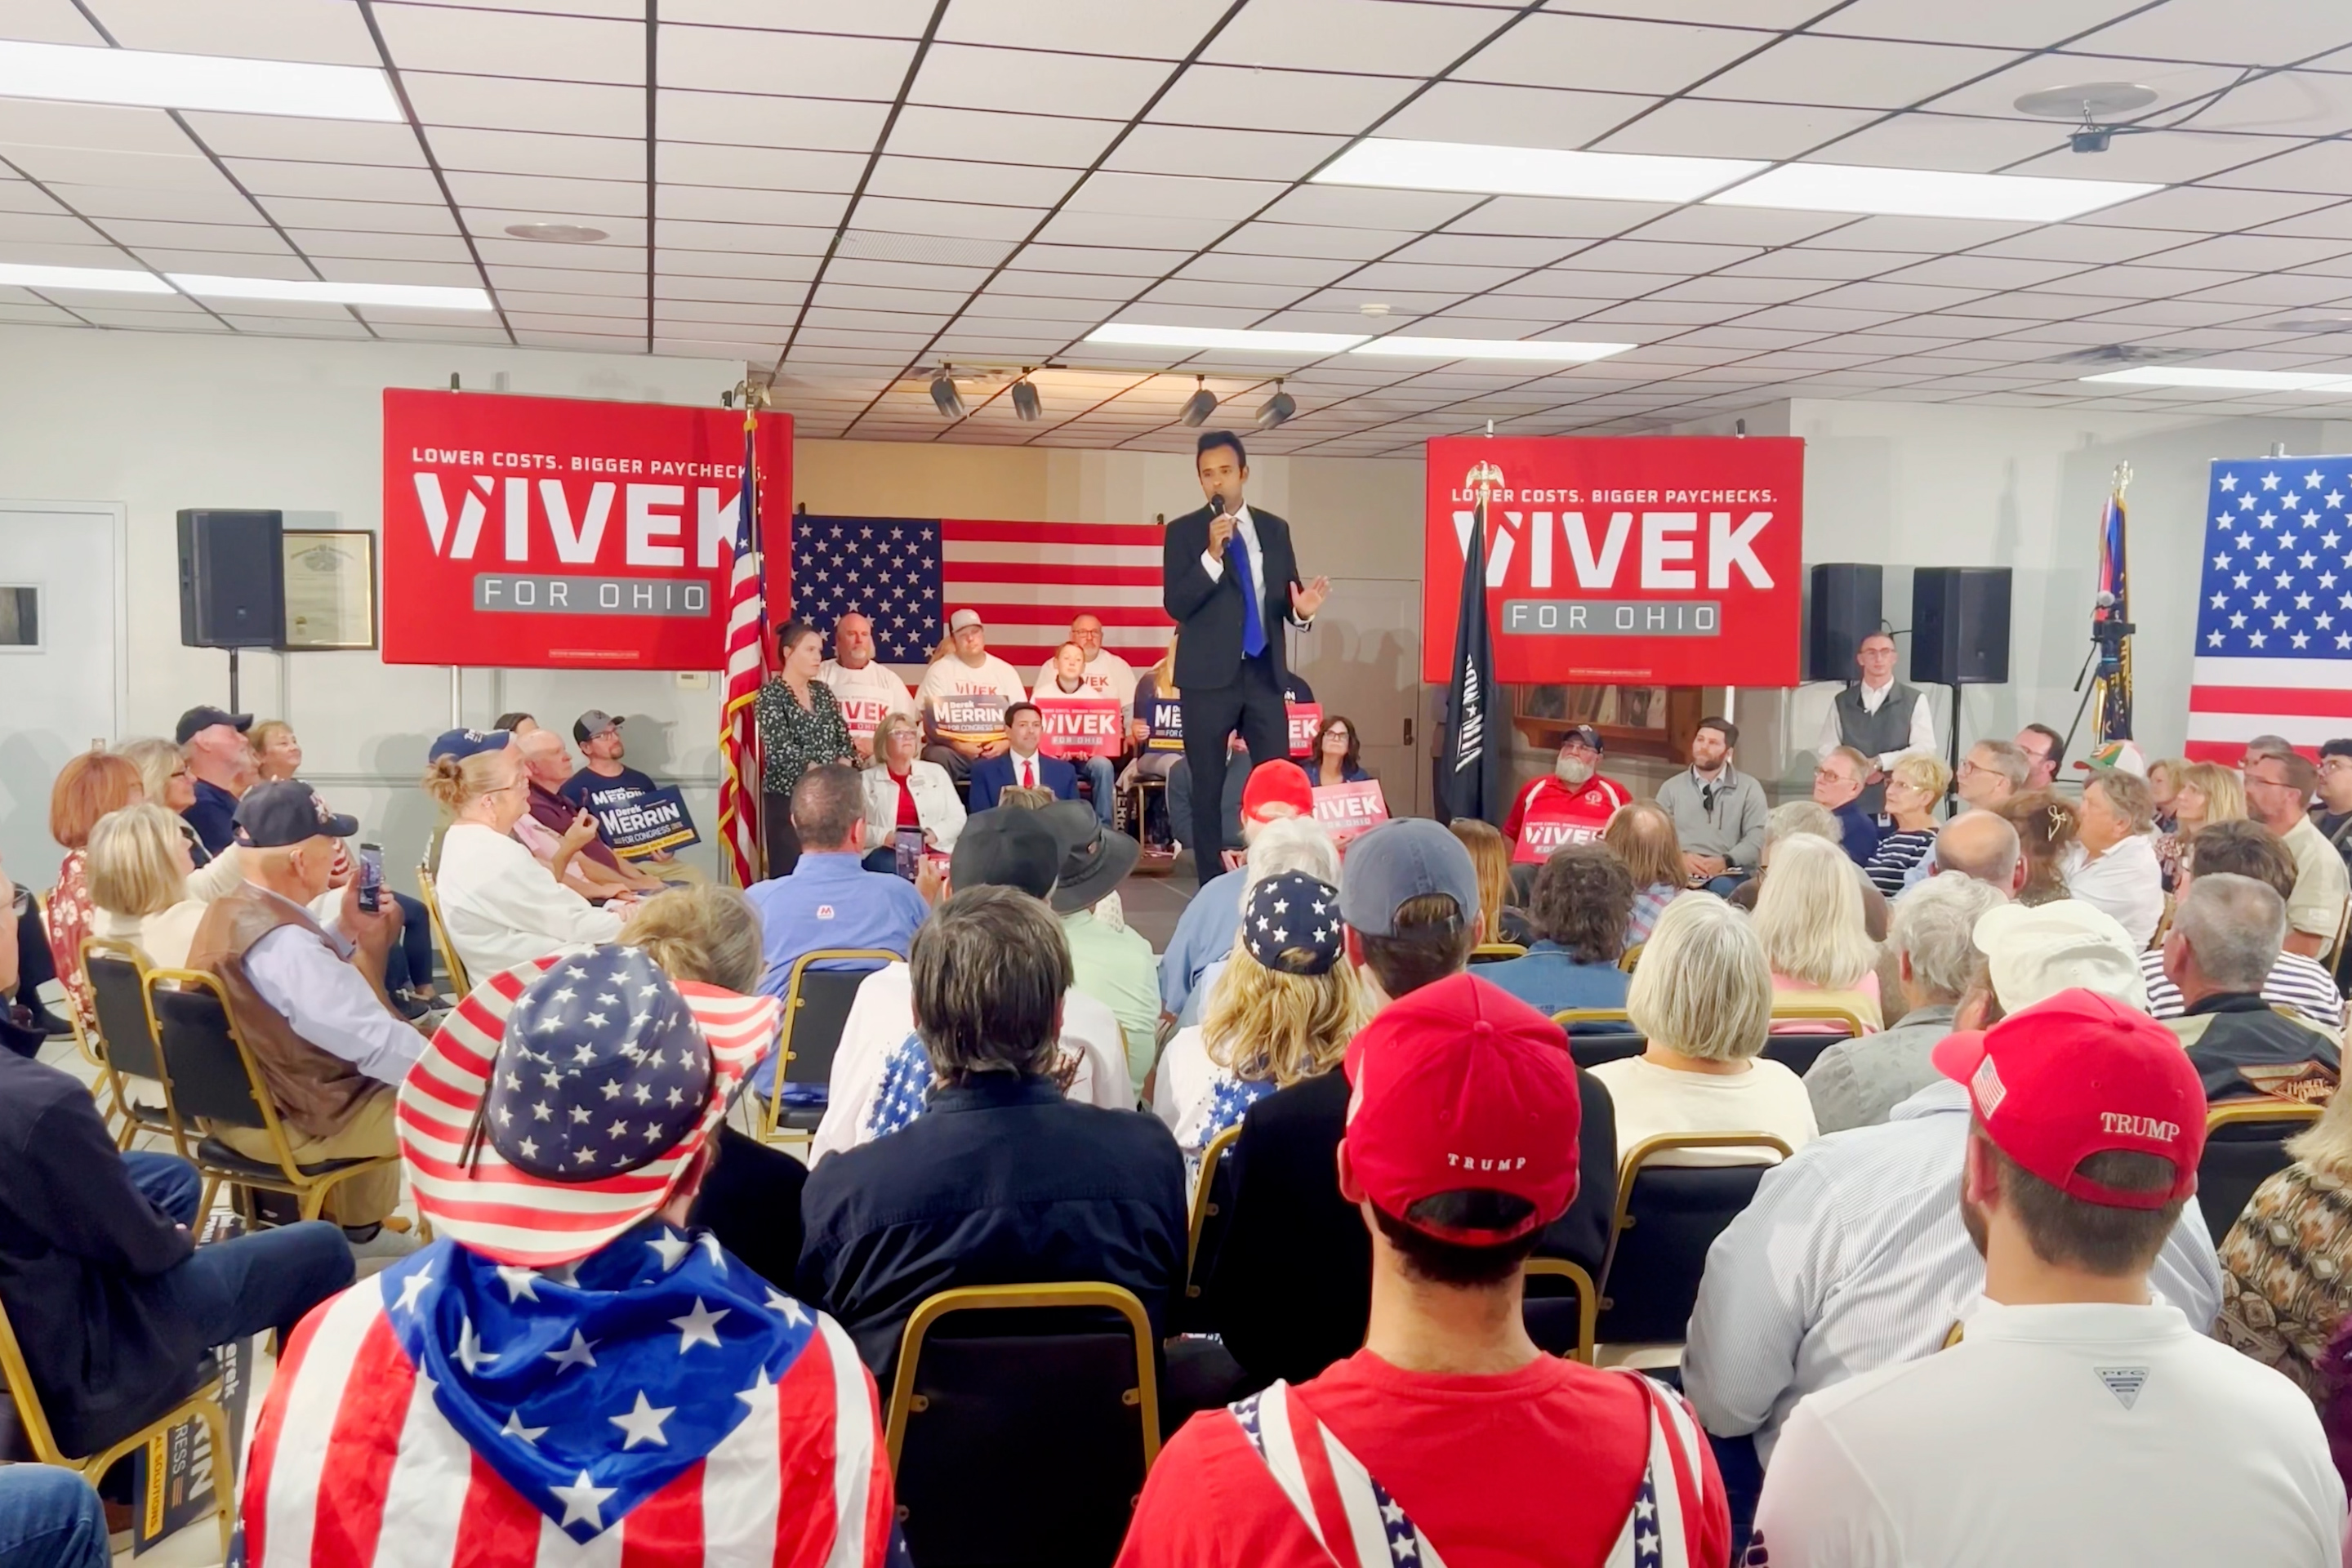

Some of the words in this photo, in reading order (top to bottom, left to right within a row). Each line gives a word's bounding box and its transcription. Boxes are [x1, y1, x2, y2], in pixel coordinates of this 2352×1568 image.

[413, 448, 484, 466] LOWER
[492, 452, 564, 470] COSTS.
[572, 456, 643, 474] BIGGER
[1521, 488, 1584, 503] COSTS.
[1592, 489, 1659, 503] BIGGER
[1665, 489, 1778, 504] PAYCHECKS.
[1452, 511, 1775, 590] VIVEK
[483, 578, 568, 607] FOR
[600, 583, 705, 610] OHIO
[1512, 604, 1588, 629] FOR
[1615, 606, 1715, 630] OHIO
[933, 702, 1004, 723] MERRIN
[950, 700, 974, 709] Derek
[1041, 713, 1116, 734] VIVEK
[599, 802, 681, 835] MERRIN
[615, 804, 643, 817] Derek
[621, 835, 635, 844] FOR
[634, 824, 671, 841] CONGRESS
[2100, 1111, 2180, 1143] TRUMP
[1448, 1152, 1526, 1171] TRUMP
[225, 1343, 239, 1400] erek
[172, 1423, 189, 1475] RESS
